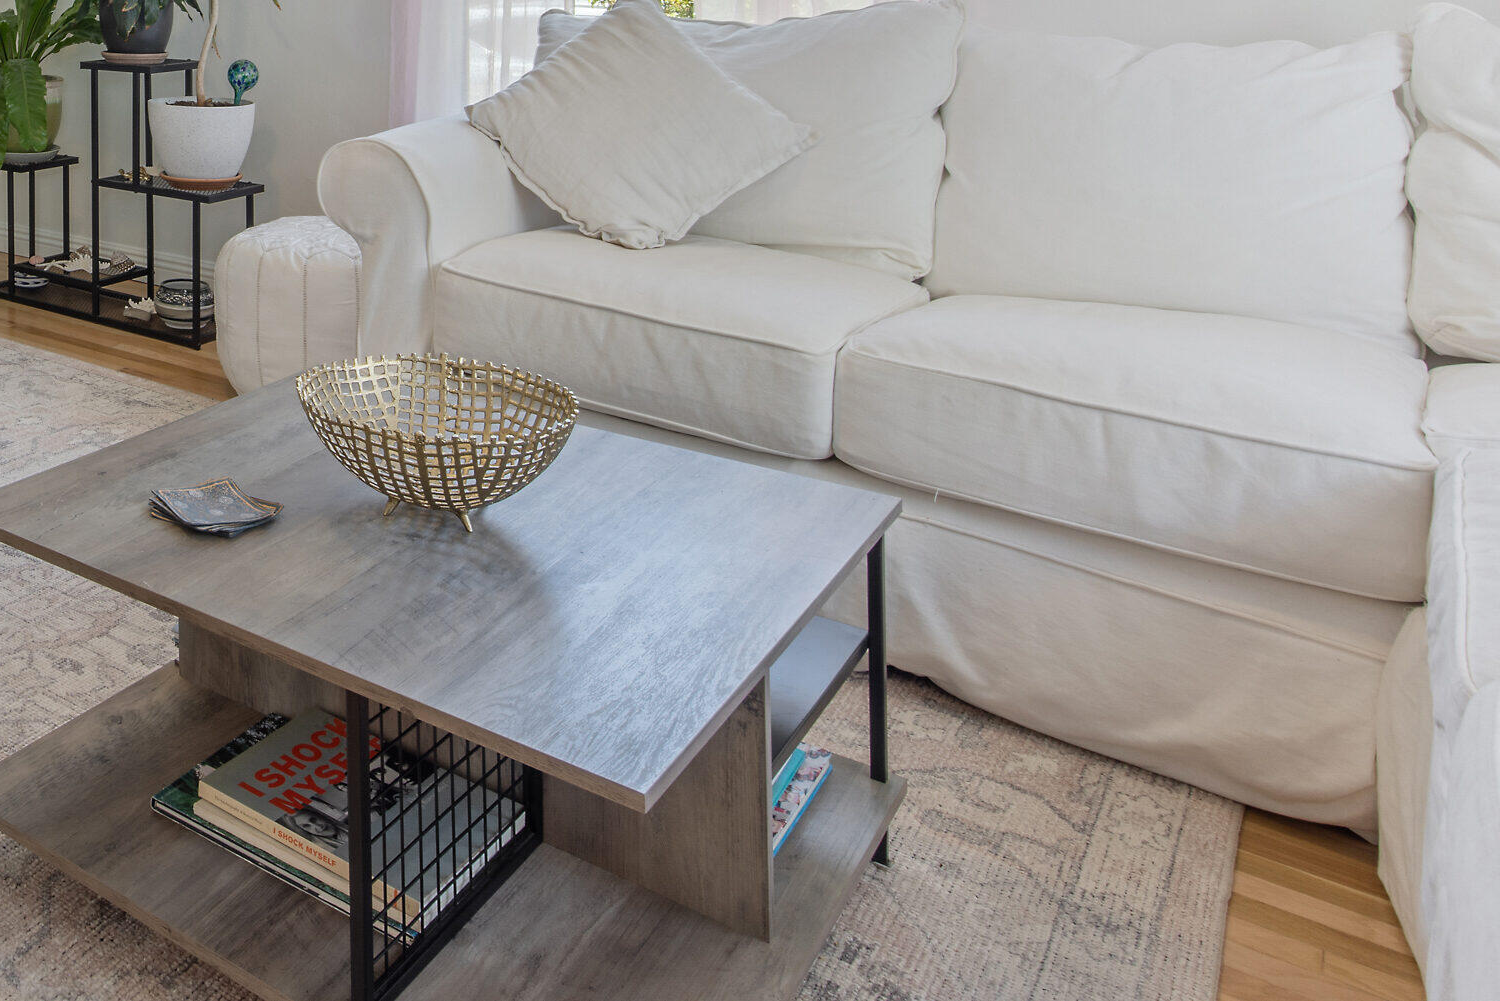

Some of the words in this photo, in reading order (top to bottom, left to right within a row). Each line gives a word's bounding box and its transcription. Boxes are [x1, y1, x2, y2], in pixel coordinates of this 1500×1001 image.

[238, 781, 265, 798] I
[254, 717, 347, 788] SHOCK
[277, 831, 304, 850] SHOCK
[306, 845, 337, 867] MYSELF
